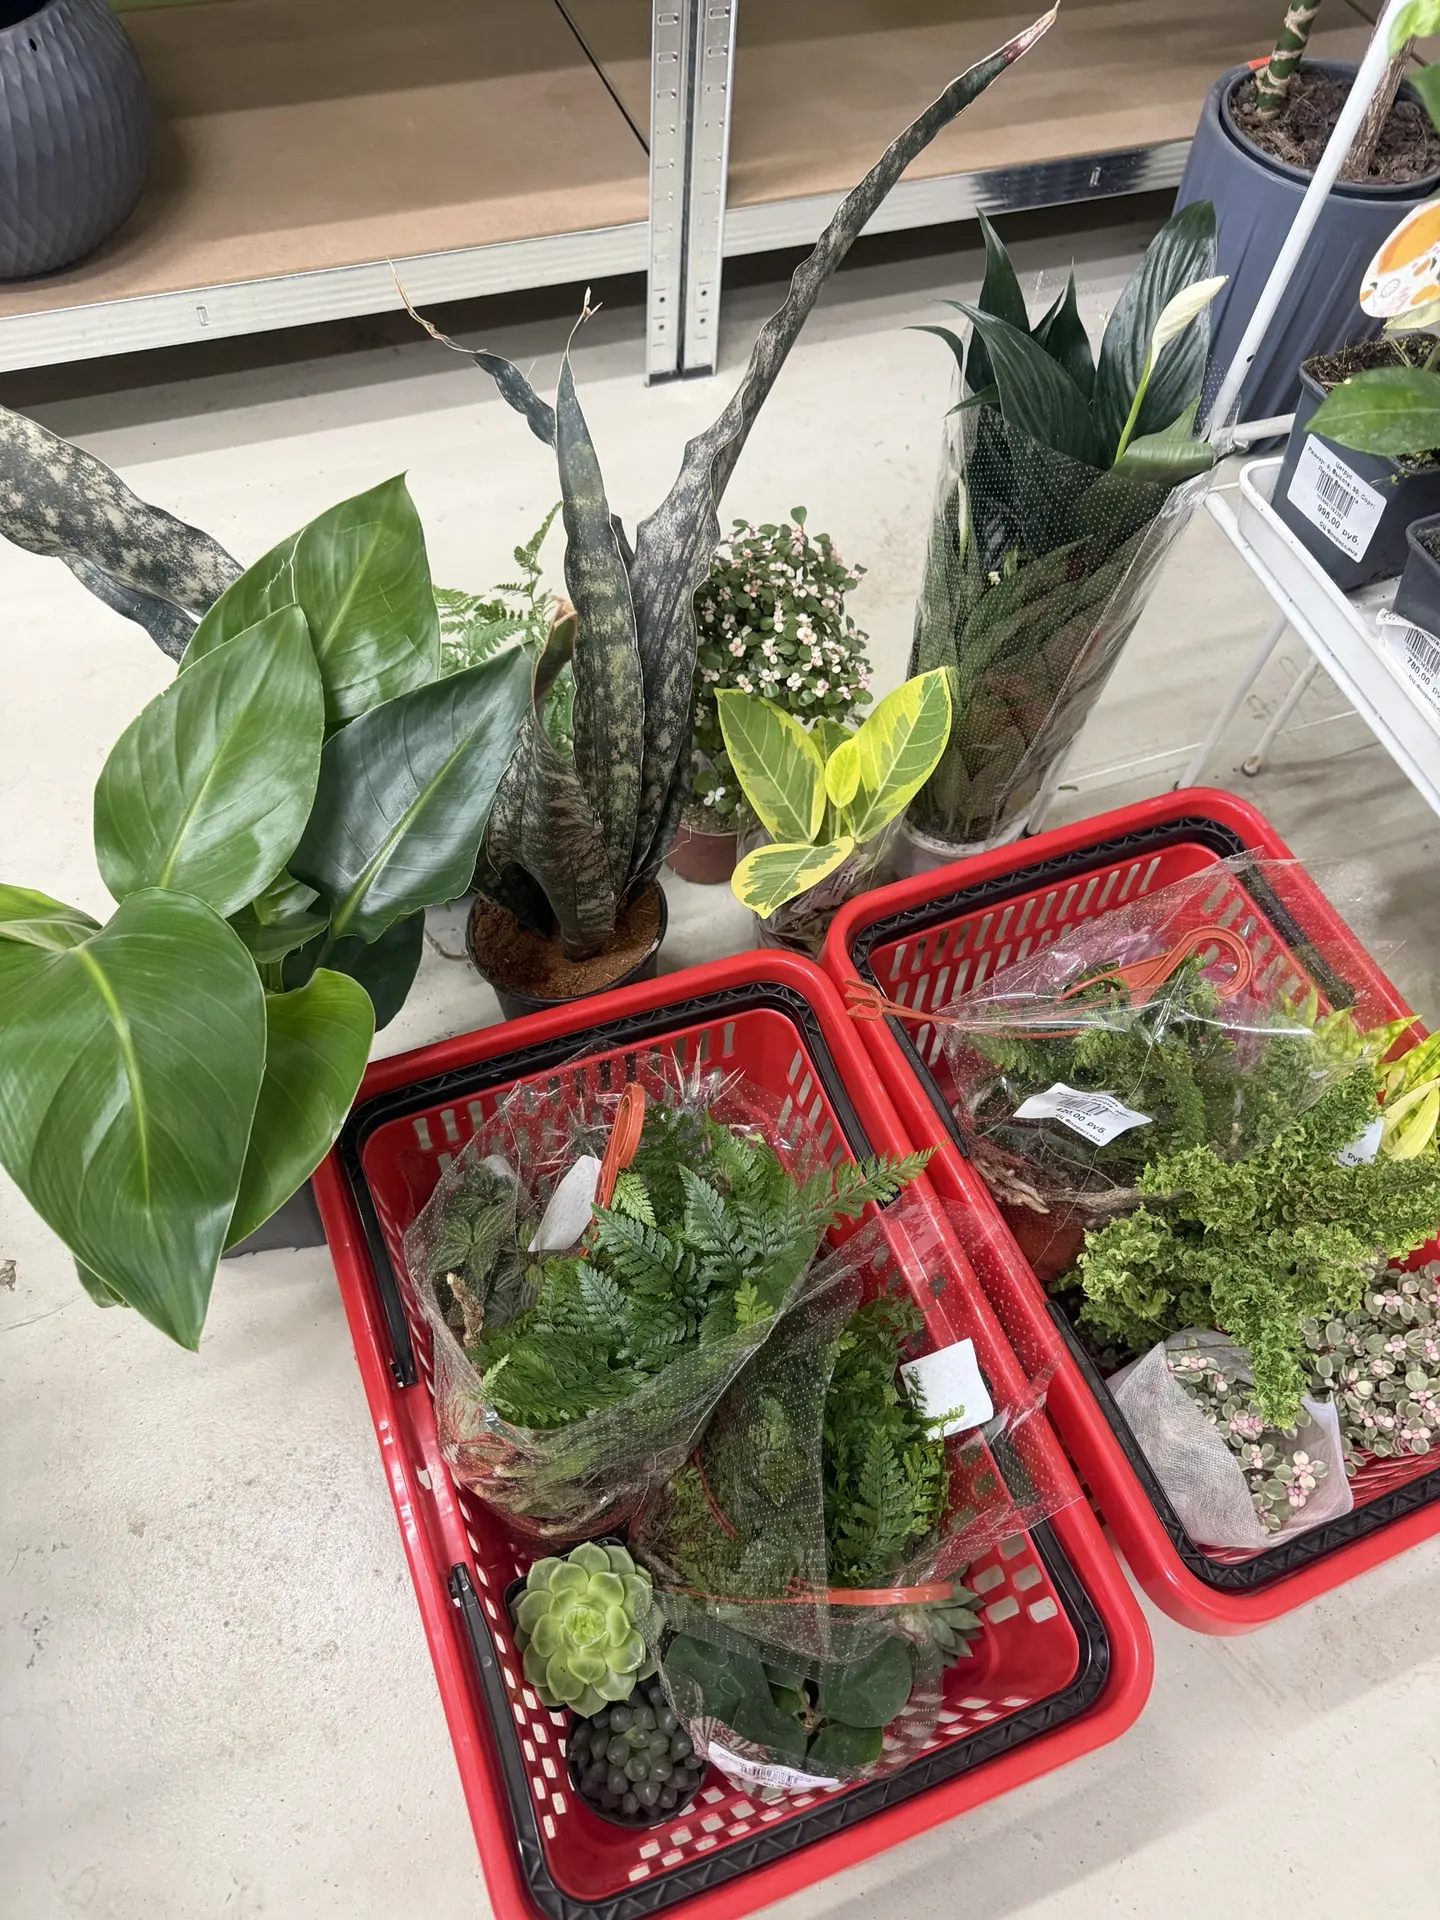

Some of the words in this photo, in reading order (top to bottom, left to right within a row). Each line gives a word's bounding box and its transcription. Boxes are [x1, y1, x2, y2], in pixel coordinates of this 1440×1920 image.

[1335, 461, 1353, 480] Цитрус
[1318, 504, 1341, 529] 995,00
[1342, 529, 1359, 546] руб.
[1407, 656, 1431, 685] 780,00
[1056, 1107, 1086, 1121] 420,00
[1087, 1122, 1107, 1135] руб.
